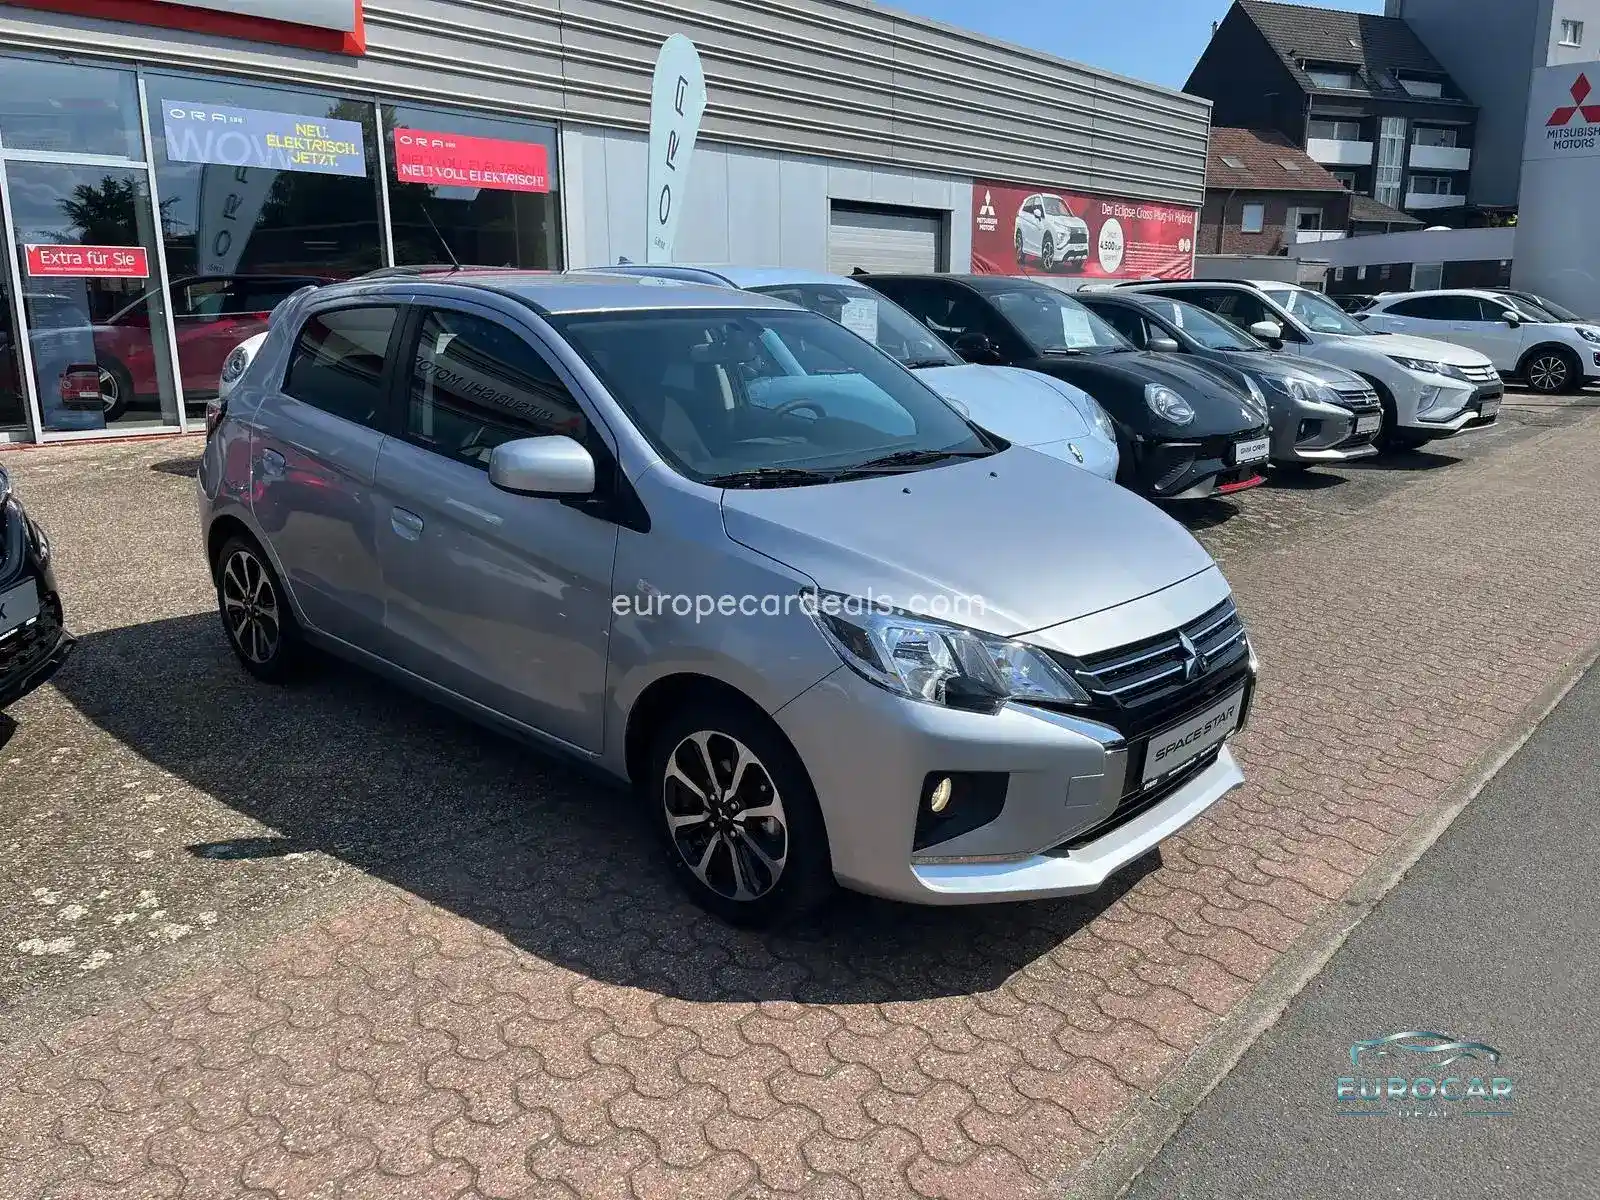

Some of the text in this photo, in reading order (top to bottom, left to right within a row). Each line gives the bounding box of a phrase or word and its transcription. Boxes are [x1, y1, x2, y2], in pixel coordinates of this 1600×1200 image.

[170, 108, 227, 124] ORA
[399, 136, 444, 148] ORA
[1553, 138, 1595, 150] MOTORS
[659, 75, 689, 226] ORA
[435, 166, 468, 181] VOLL
[1101, 203, 1114, 215] Der
[1114, 204, 1135, 220] Eclipse
[1136, 207, 1153, 220] Cross
[1174, 211, 1193, 226] Hybrid
[40, 250, 136, 266] Extra für Sie
[1155, 727, 1203, 762] SPACE
[1203, 705, 1235, 735] STAR
